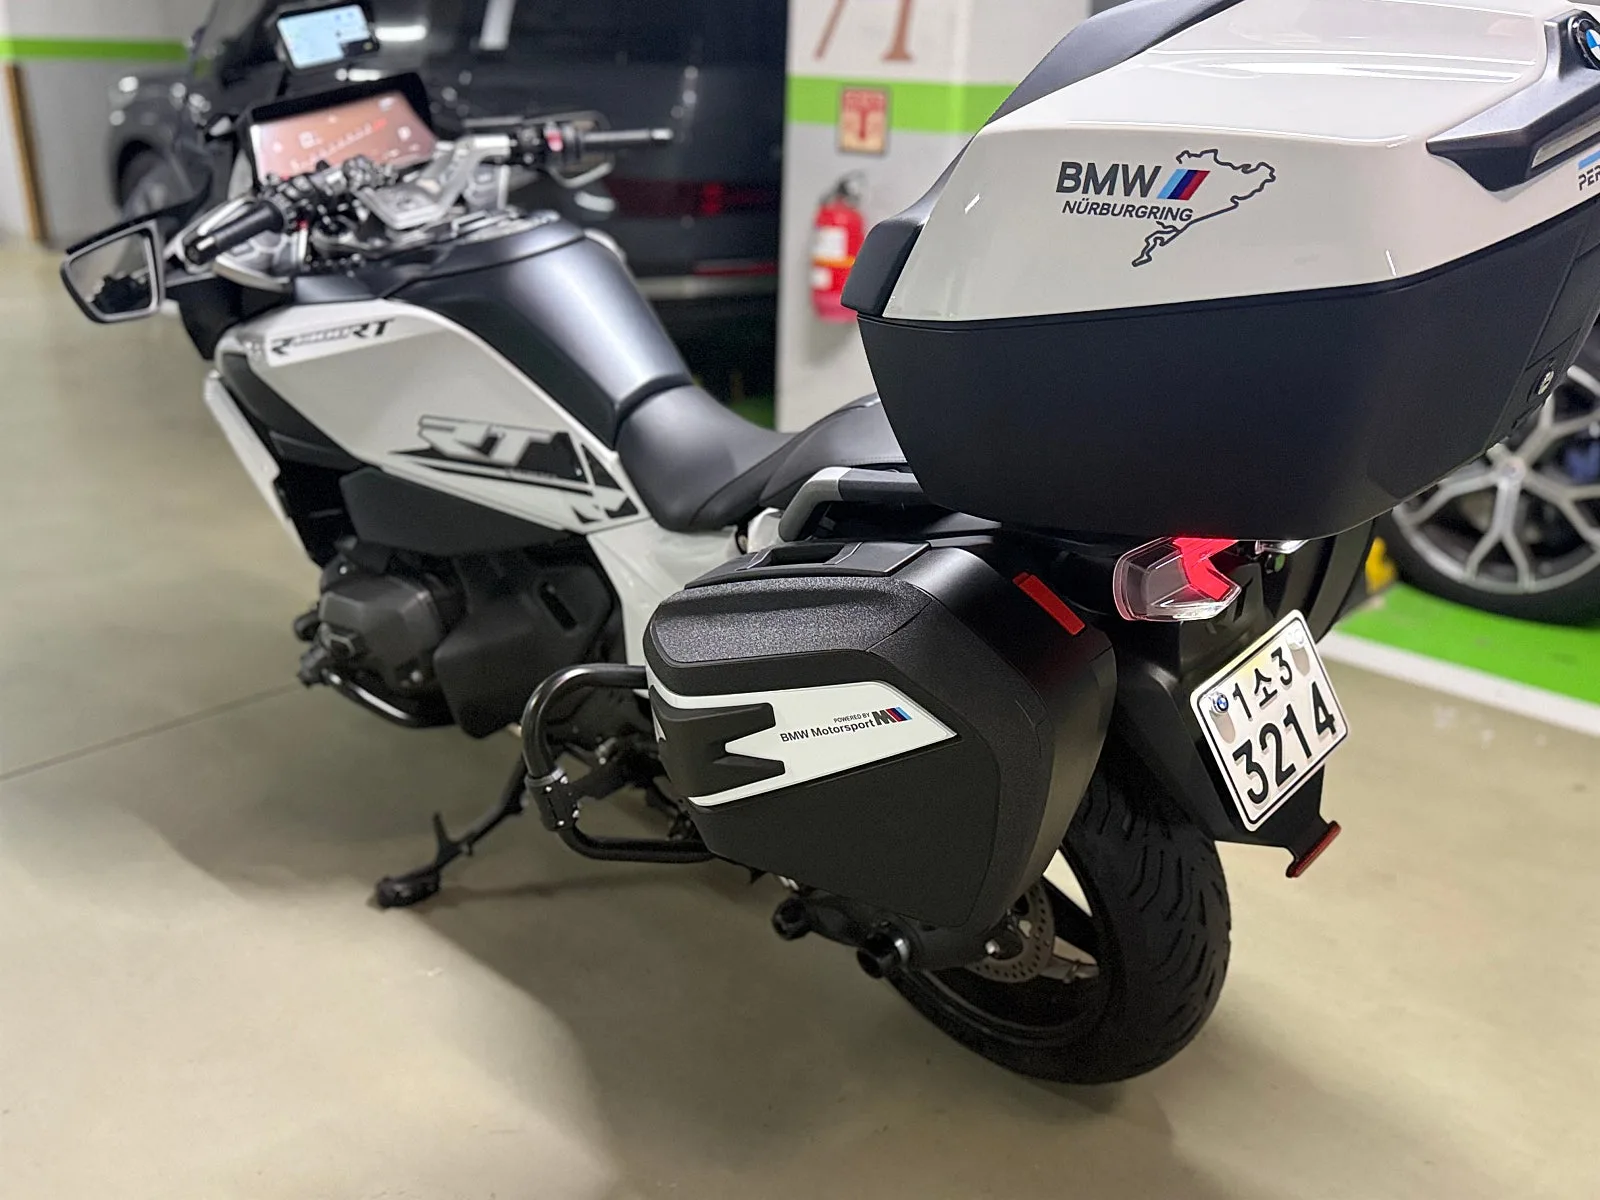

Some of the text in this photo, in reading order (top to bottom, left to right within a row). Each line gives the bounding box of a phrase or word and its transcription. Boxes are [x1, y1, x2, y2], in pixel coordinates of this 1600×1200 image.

[1056, 161, 1162, 198] BMW
[1062, 198, 1194, 222] NÜRBURGRING
[833, 713, 862, 723] POWERED
[780, 719, 876, 742] BMW Motorsport
[1232, 681, 1337, 805] 3214
